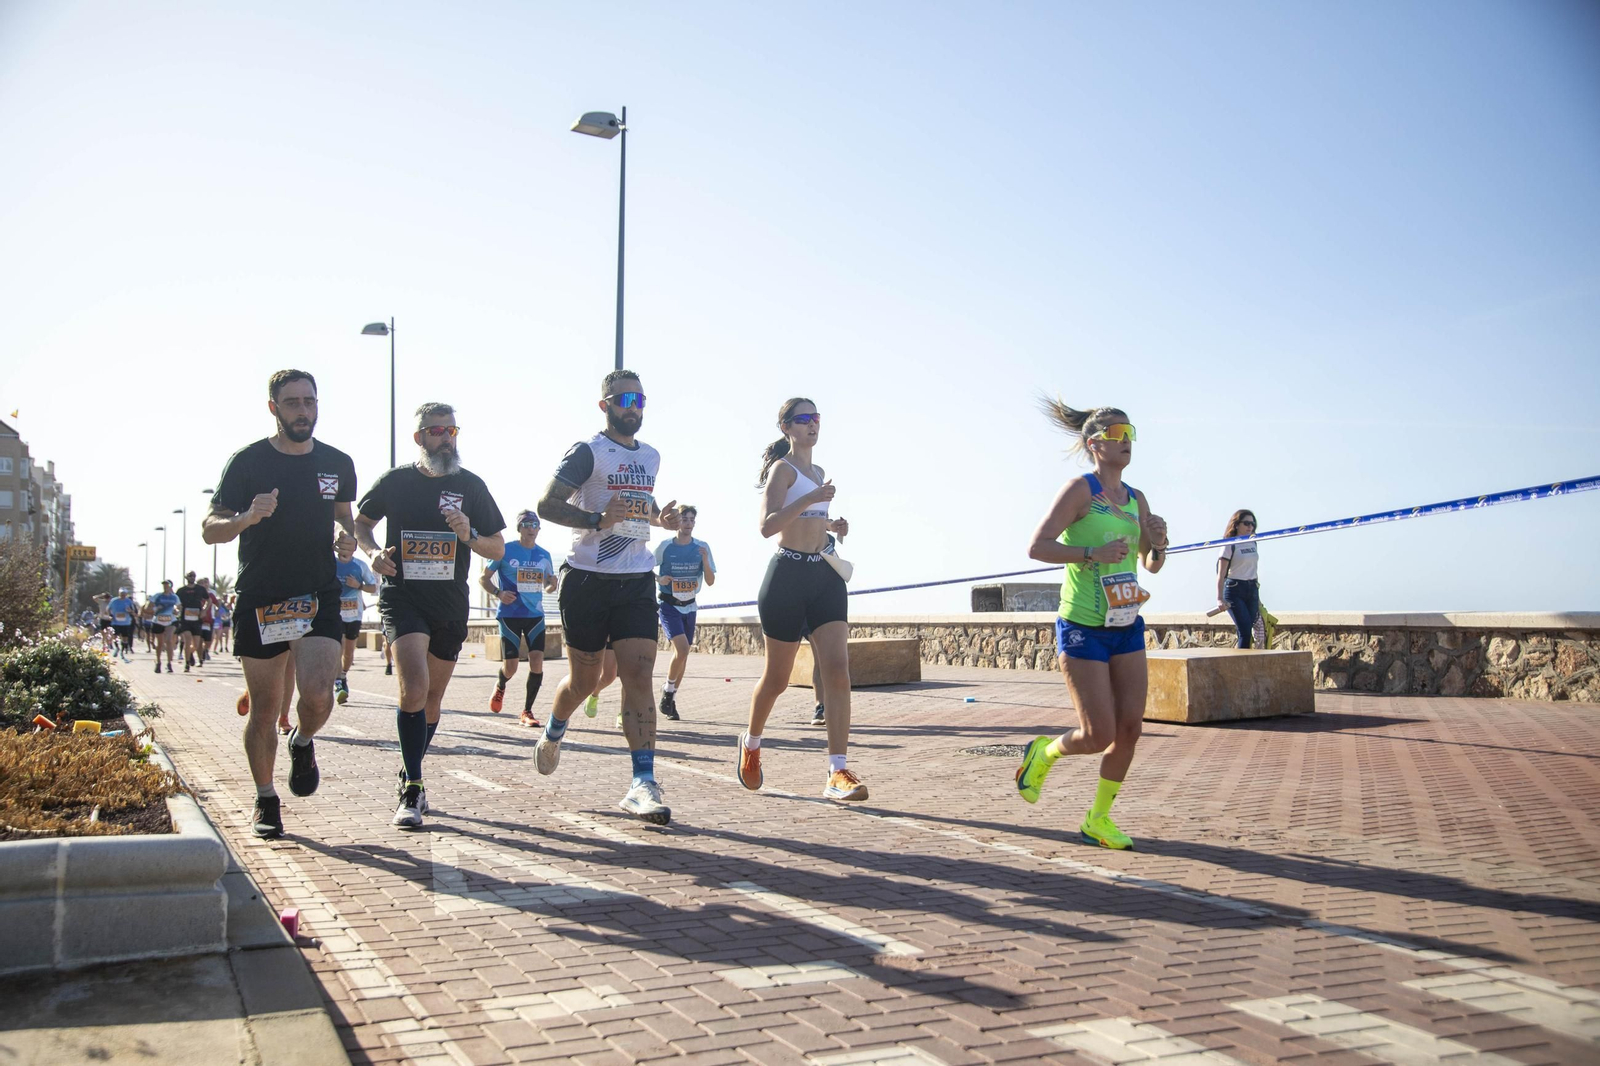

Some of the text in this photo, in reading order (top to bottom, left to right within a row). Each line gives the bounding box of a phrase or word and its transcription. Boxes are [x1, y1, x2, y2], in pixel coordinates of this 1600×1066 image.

[628, 464, 646, 475] SAN
[406, 541, 451, 556] 2260
[778, 547, 802, 560] PRO
[520, 571, 542, 580] 1624
[675, 581, 697, 589] 1835
[264, 600, 312, 616] 2245
